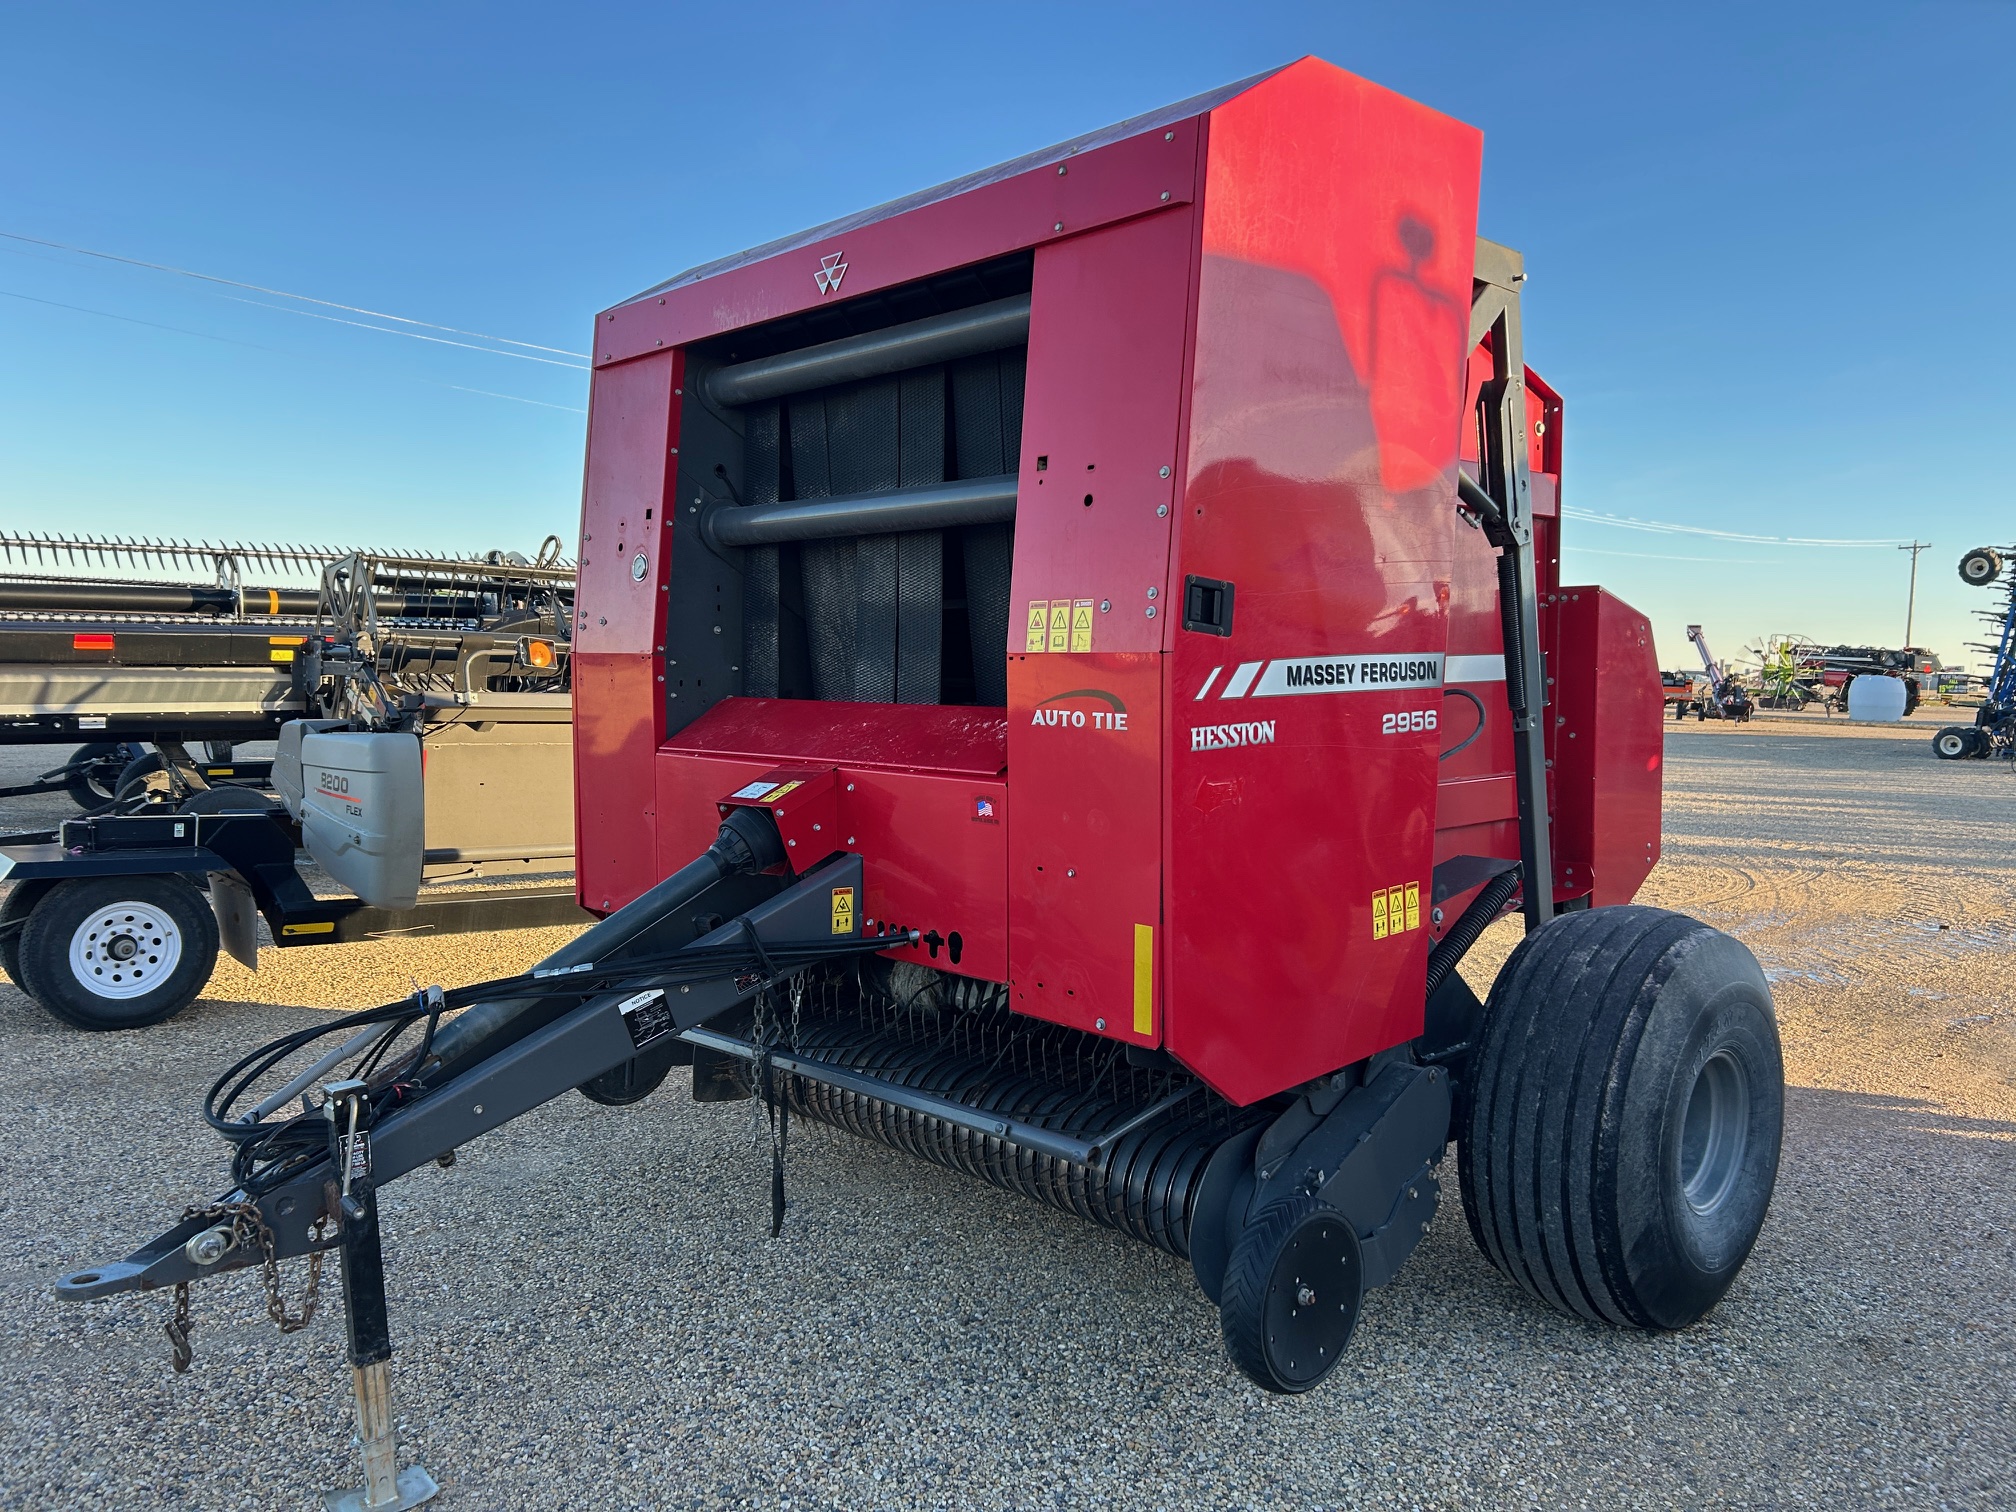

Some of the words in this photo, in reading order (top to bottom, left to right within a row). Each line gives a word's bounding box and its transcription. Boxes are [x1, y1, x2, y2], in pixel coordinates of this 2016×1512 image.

[1286, 662, 1356, 687] MASSEY
[1360, 660, 1437, 684] FERGUSON
[1031, 709, 1086, 728] AUTO
[1092, 711, 1128, 731] TIE
[1382, 709, 1438, 735] 2956
[1190, 719, 1276, 752] HESSTON
[320, 771, 349, 794] 8200
[345, 804, 363, 818] FLEX
[631, 992, 652, 1006] NOTICE
